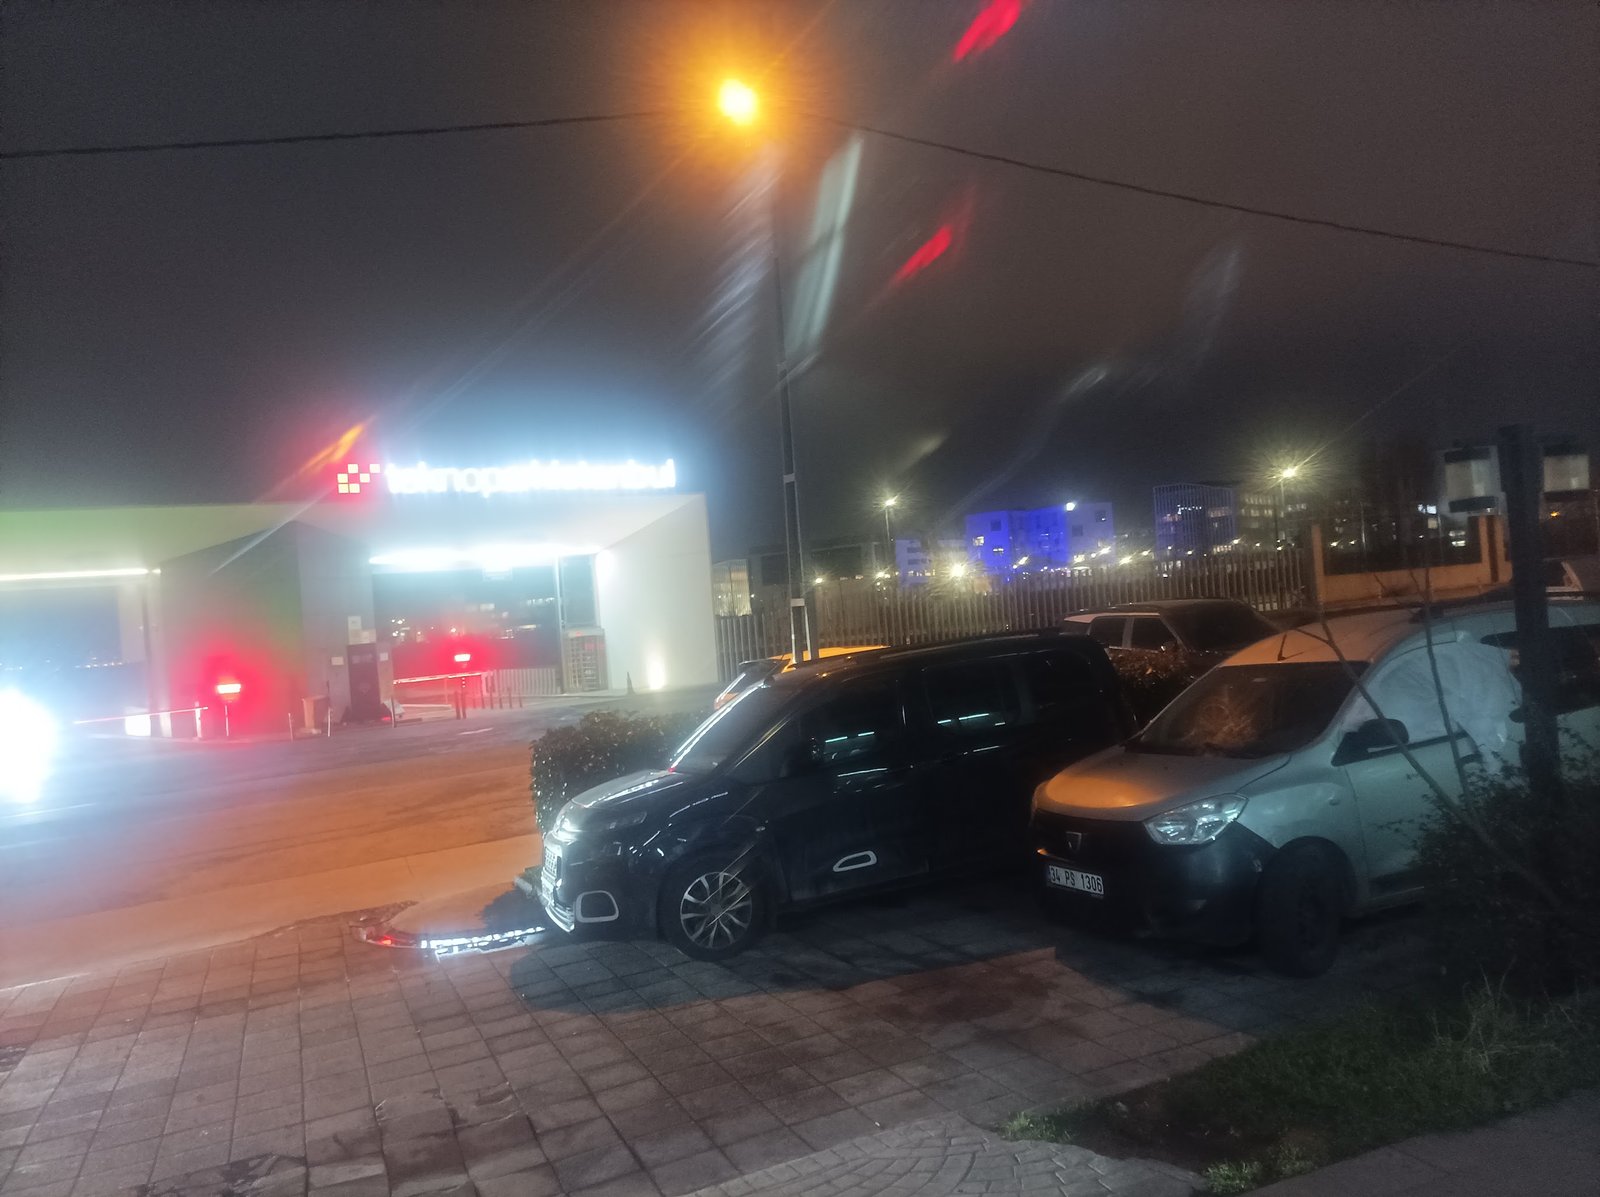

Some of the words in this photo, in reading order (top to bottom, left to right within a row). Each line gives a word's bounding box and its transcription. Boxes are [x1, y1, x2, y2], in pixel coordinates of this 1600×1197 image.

[1050, 867, 1061, 883] 34
[1064, 870, 1076, 887] PS
[1080, 873, 1103, 893] 1306
